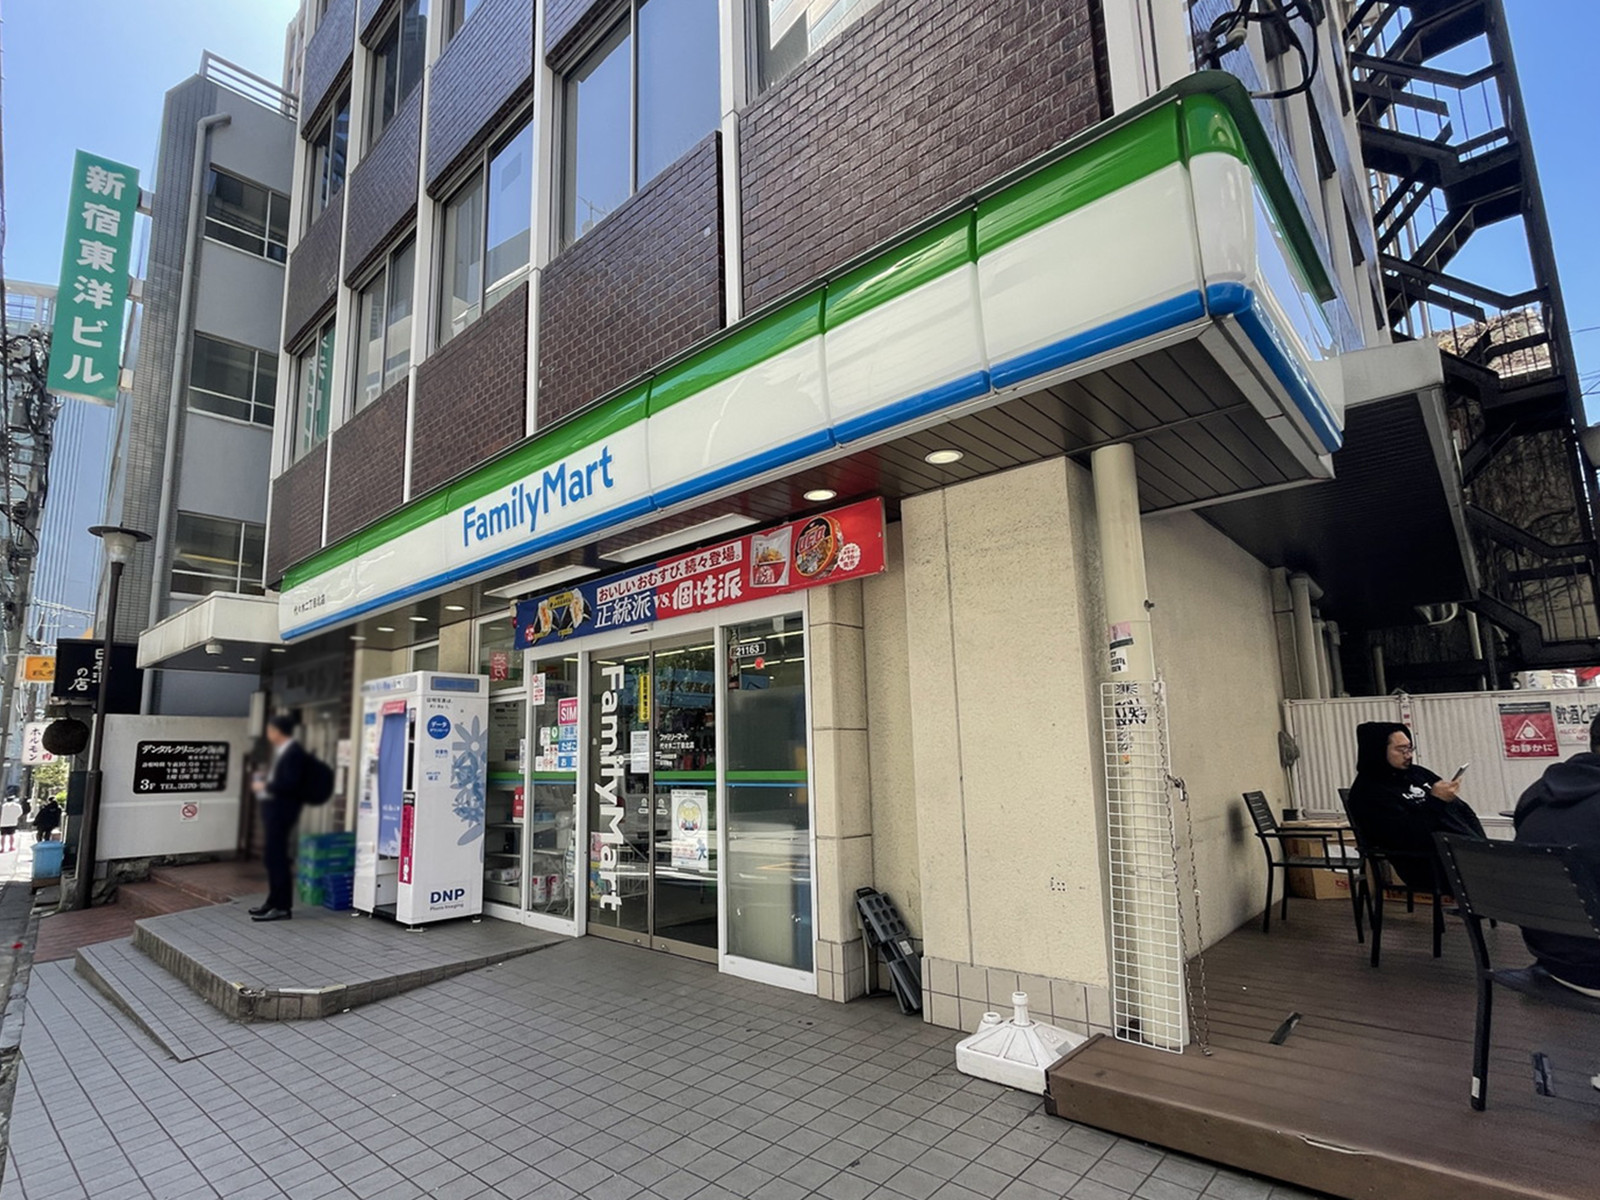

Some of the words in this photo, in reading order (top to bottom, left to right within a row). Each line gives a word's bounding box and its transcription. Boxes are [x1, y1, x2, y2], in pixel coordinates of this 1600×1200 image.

[63, 164, 126, 385] 新宿東洋ビル
[463, 445, 614, 547] FamilyMart
[594, 591, 652, 629] 正統派
[672, 567, 743, 611] 個性派
[29, 728, 41, 761] ホルモン
[1510, 743, 1554, 753] お静かに
[593, 664, 626, 912] FamilyMart
[430, 888, 465, 904] DNP
